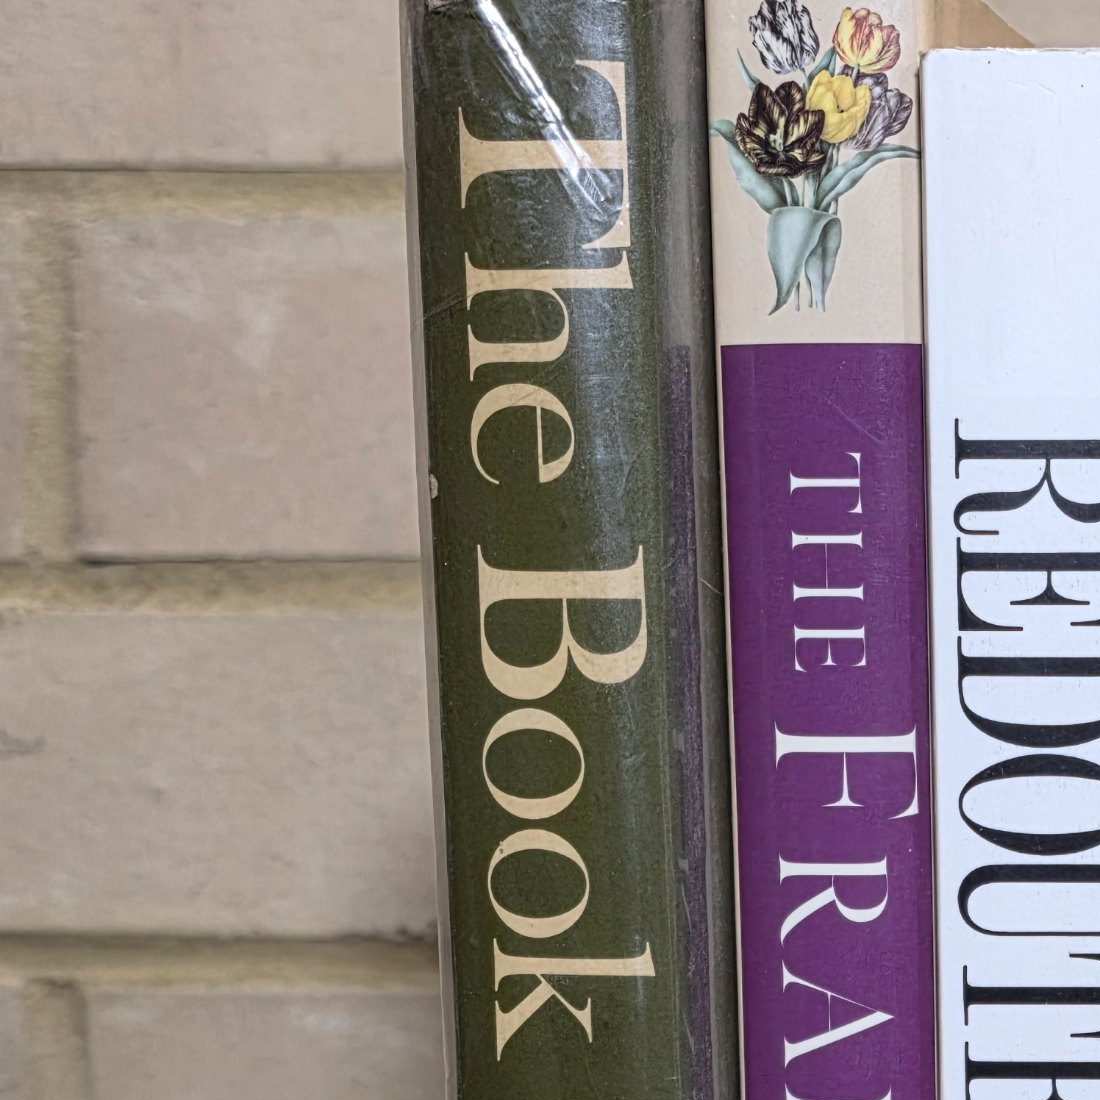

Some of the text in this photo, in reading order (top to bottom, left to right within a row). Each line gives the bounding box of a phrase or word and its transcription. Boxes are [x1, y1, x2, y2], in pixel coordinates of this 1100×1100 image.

[459, 59, 635, 486] The
[789, 452, 866, 673] THE
[477, 544, 656, 1062] Book
